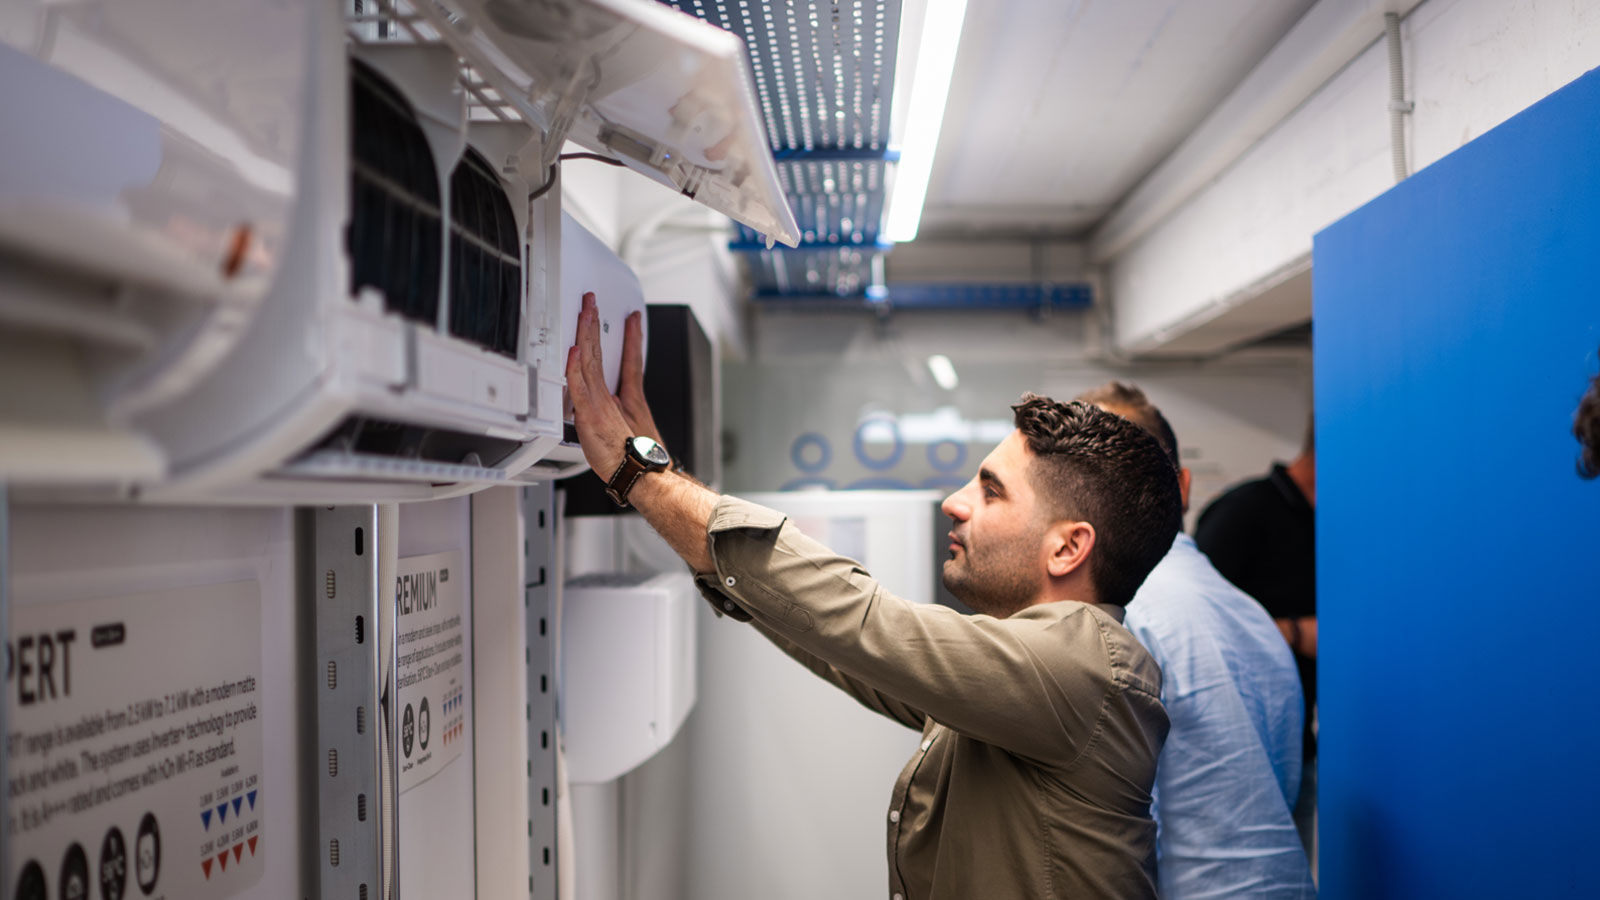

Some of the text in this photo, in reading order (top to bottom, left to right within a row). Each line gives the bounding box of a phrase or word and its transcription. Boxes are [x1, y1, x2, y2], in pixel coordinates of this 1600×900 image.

[105, 712, 126, 731] from
[211, 683, 236, 702] modern
[237, 676, 256, 694] matte
[80, 751, 98, 776] The
[186, 713, 224, 740] technology
[225, 709, 233, 726] to
[233, 701, 256, 728] provide
[205, 736, 236, 763] standard.
